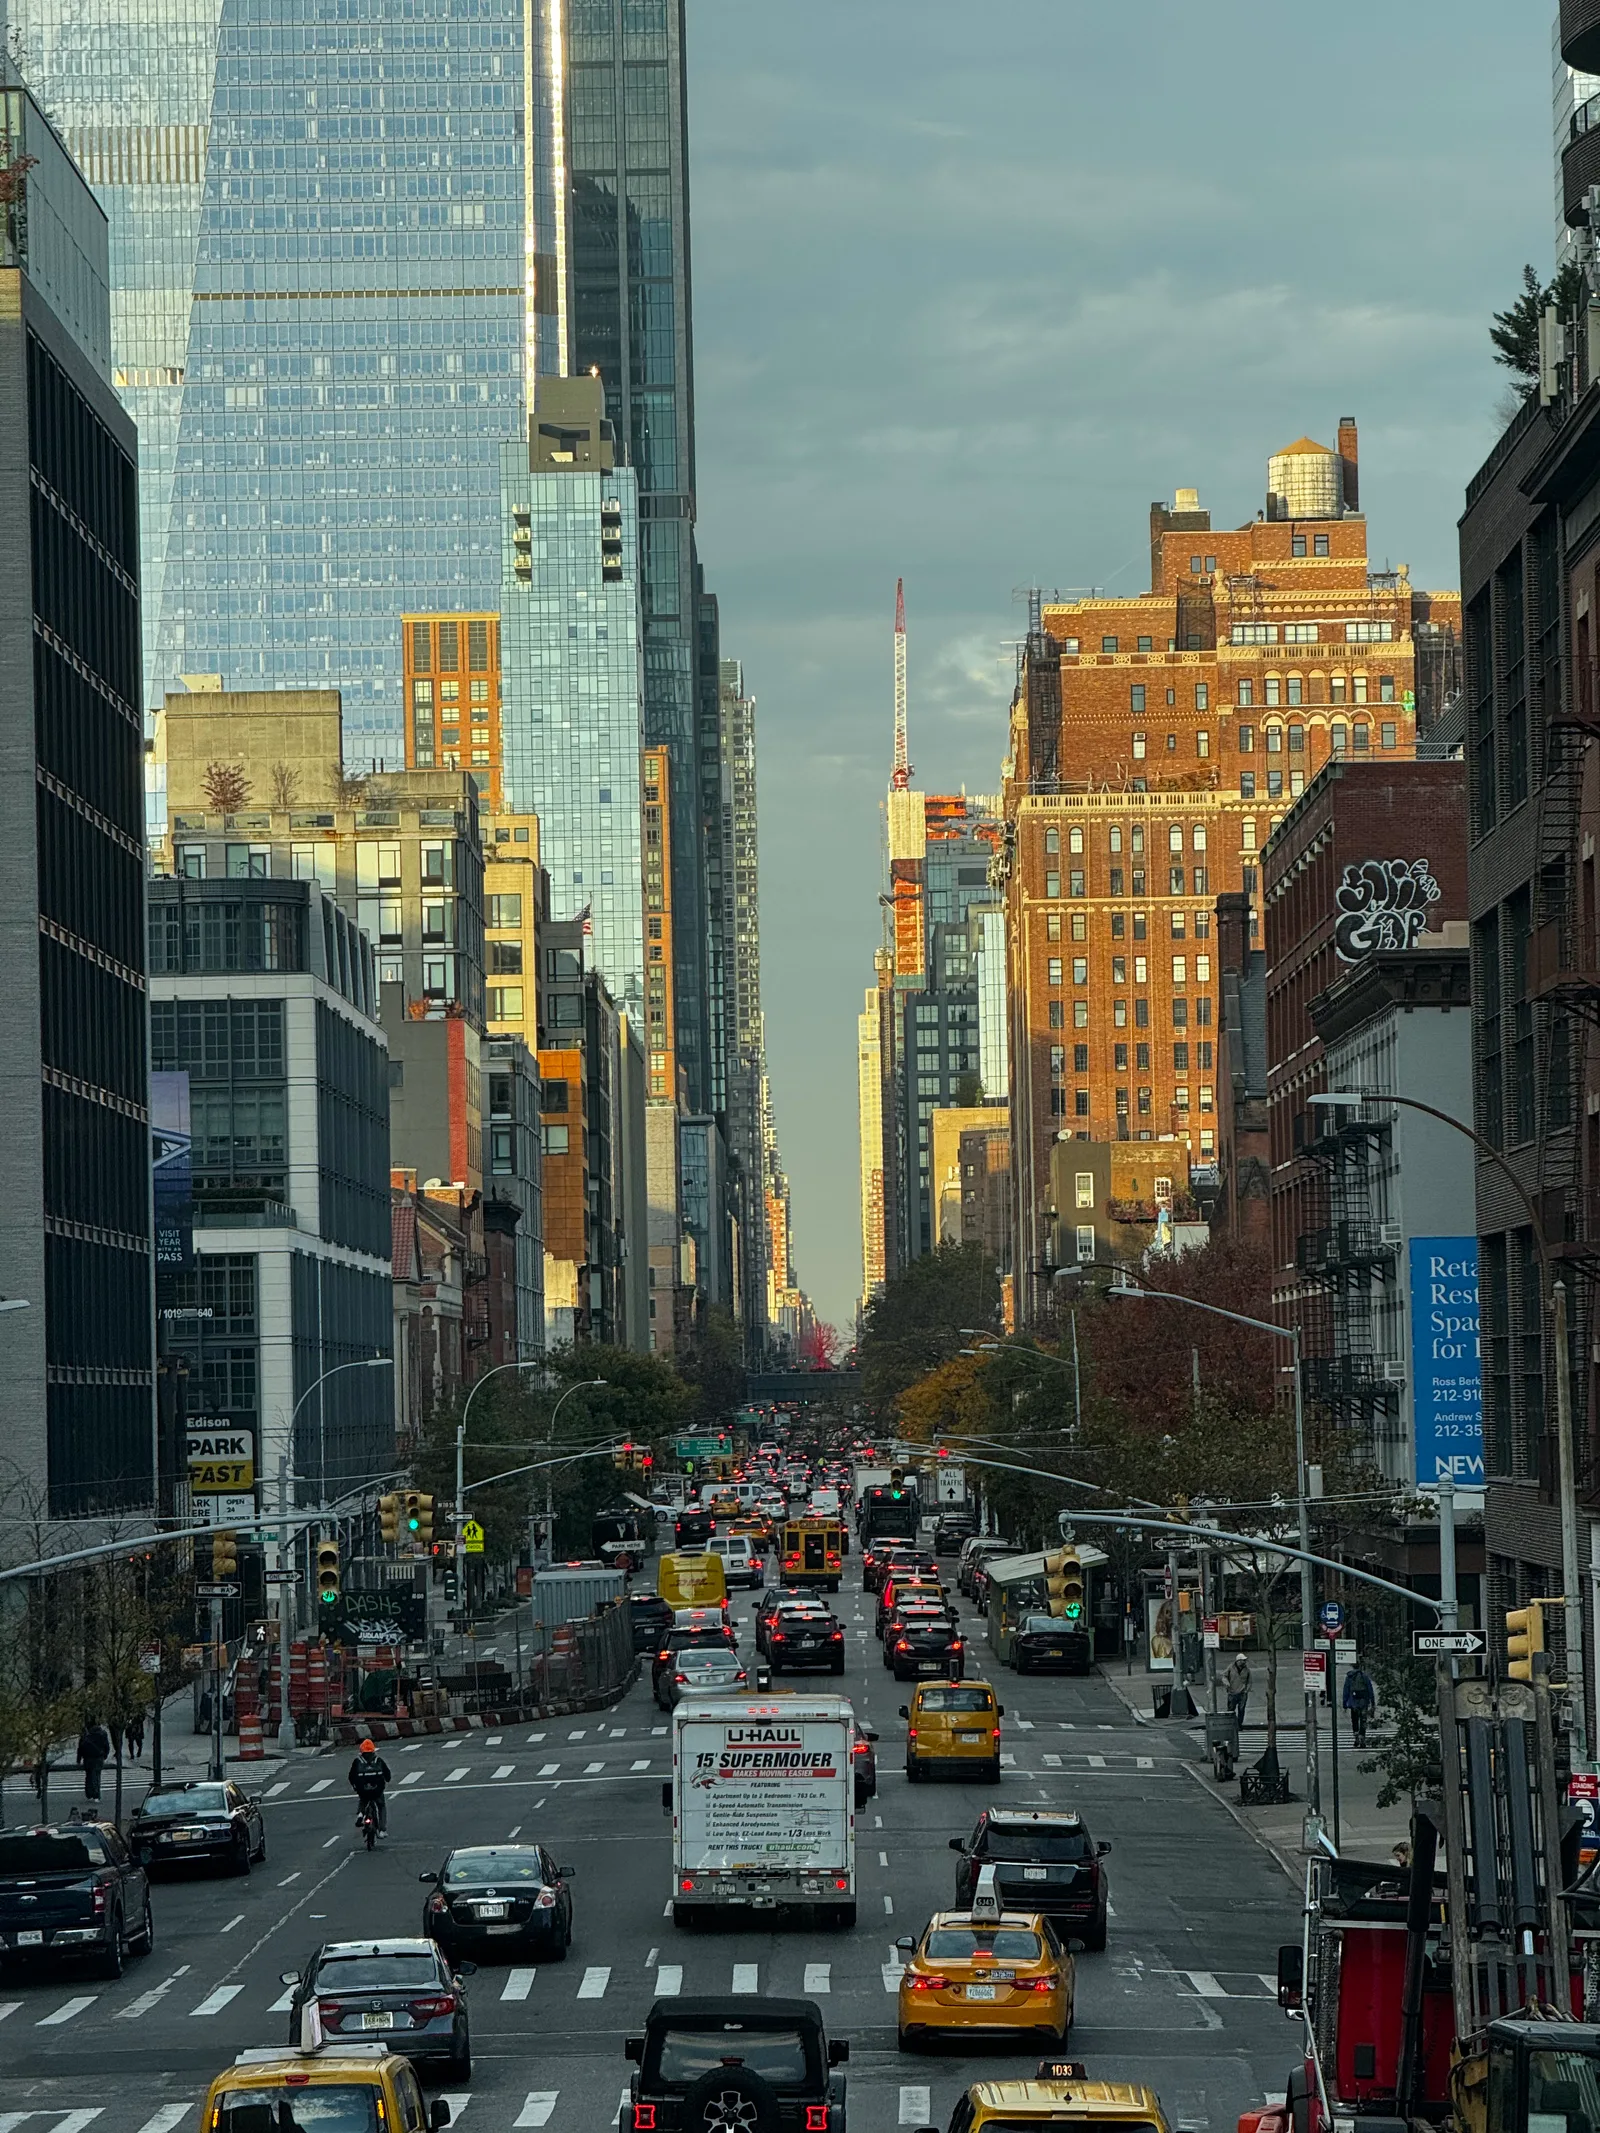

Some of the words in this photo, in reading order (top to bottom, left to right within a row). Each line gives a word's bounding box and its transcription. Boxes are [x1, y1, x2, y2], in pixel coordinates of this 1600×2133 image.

[159, 1229, 181, 1238] VISIT
[159, 1238, 181, 1246] YEAR
[157, 1252, 183, 1262] PASS
[1430, 1256, 1479, 1278] Reta
[197, 1307, 213, 1318] 640
[1432, 1337, 1467, 1359] for
[1432, 1376, 1457, 1387] Ross
[186, 1416, 231, 1428] Edison
[1434, 1412, 1473, 1422] Andrew
[1434, 1424, 1483, 1437] 212-35
[187, 1437, 246, 1456] PARK
[189, 1465, 246, 1484] FAST
[226, 1498, 245, 1506] OPEN
[226, 1506, 236, 1514] 24
[286, 1572, 299, 1580] WAY
[201, 1586, 214, 1594] ONE
[220, 1586, 235, 1594] WAY
[1424, 1638, 1445, 1648] ONE
[1454, 1638, 1476, 1647] WAY
[728, 1729, 801, 1742] U-HAUL
[696, 1752, 719, 1768] 15'
[719, 1752, 833, 1768] SUPERMOVER
[732, 1769, 758, 1778] MAKES
[759, 1769, 788, 1778] MOVING
[788, 1769, 814, 1777] EASIER
[1571, 1782, 1595, 1790] STANDING
[788, 1829, 803, 1838] 1/3
[1051, 2064, 1073, 2077] 1D33
